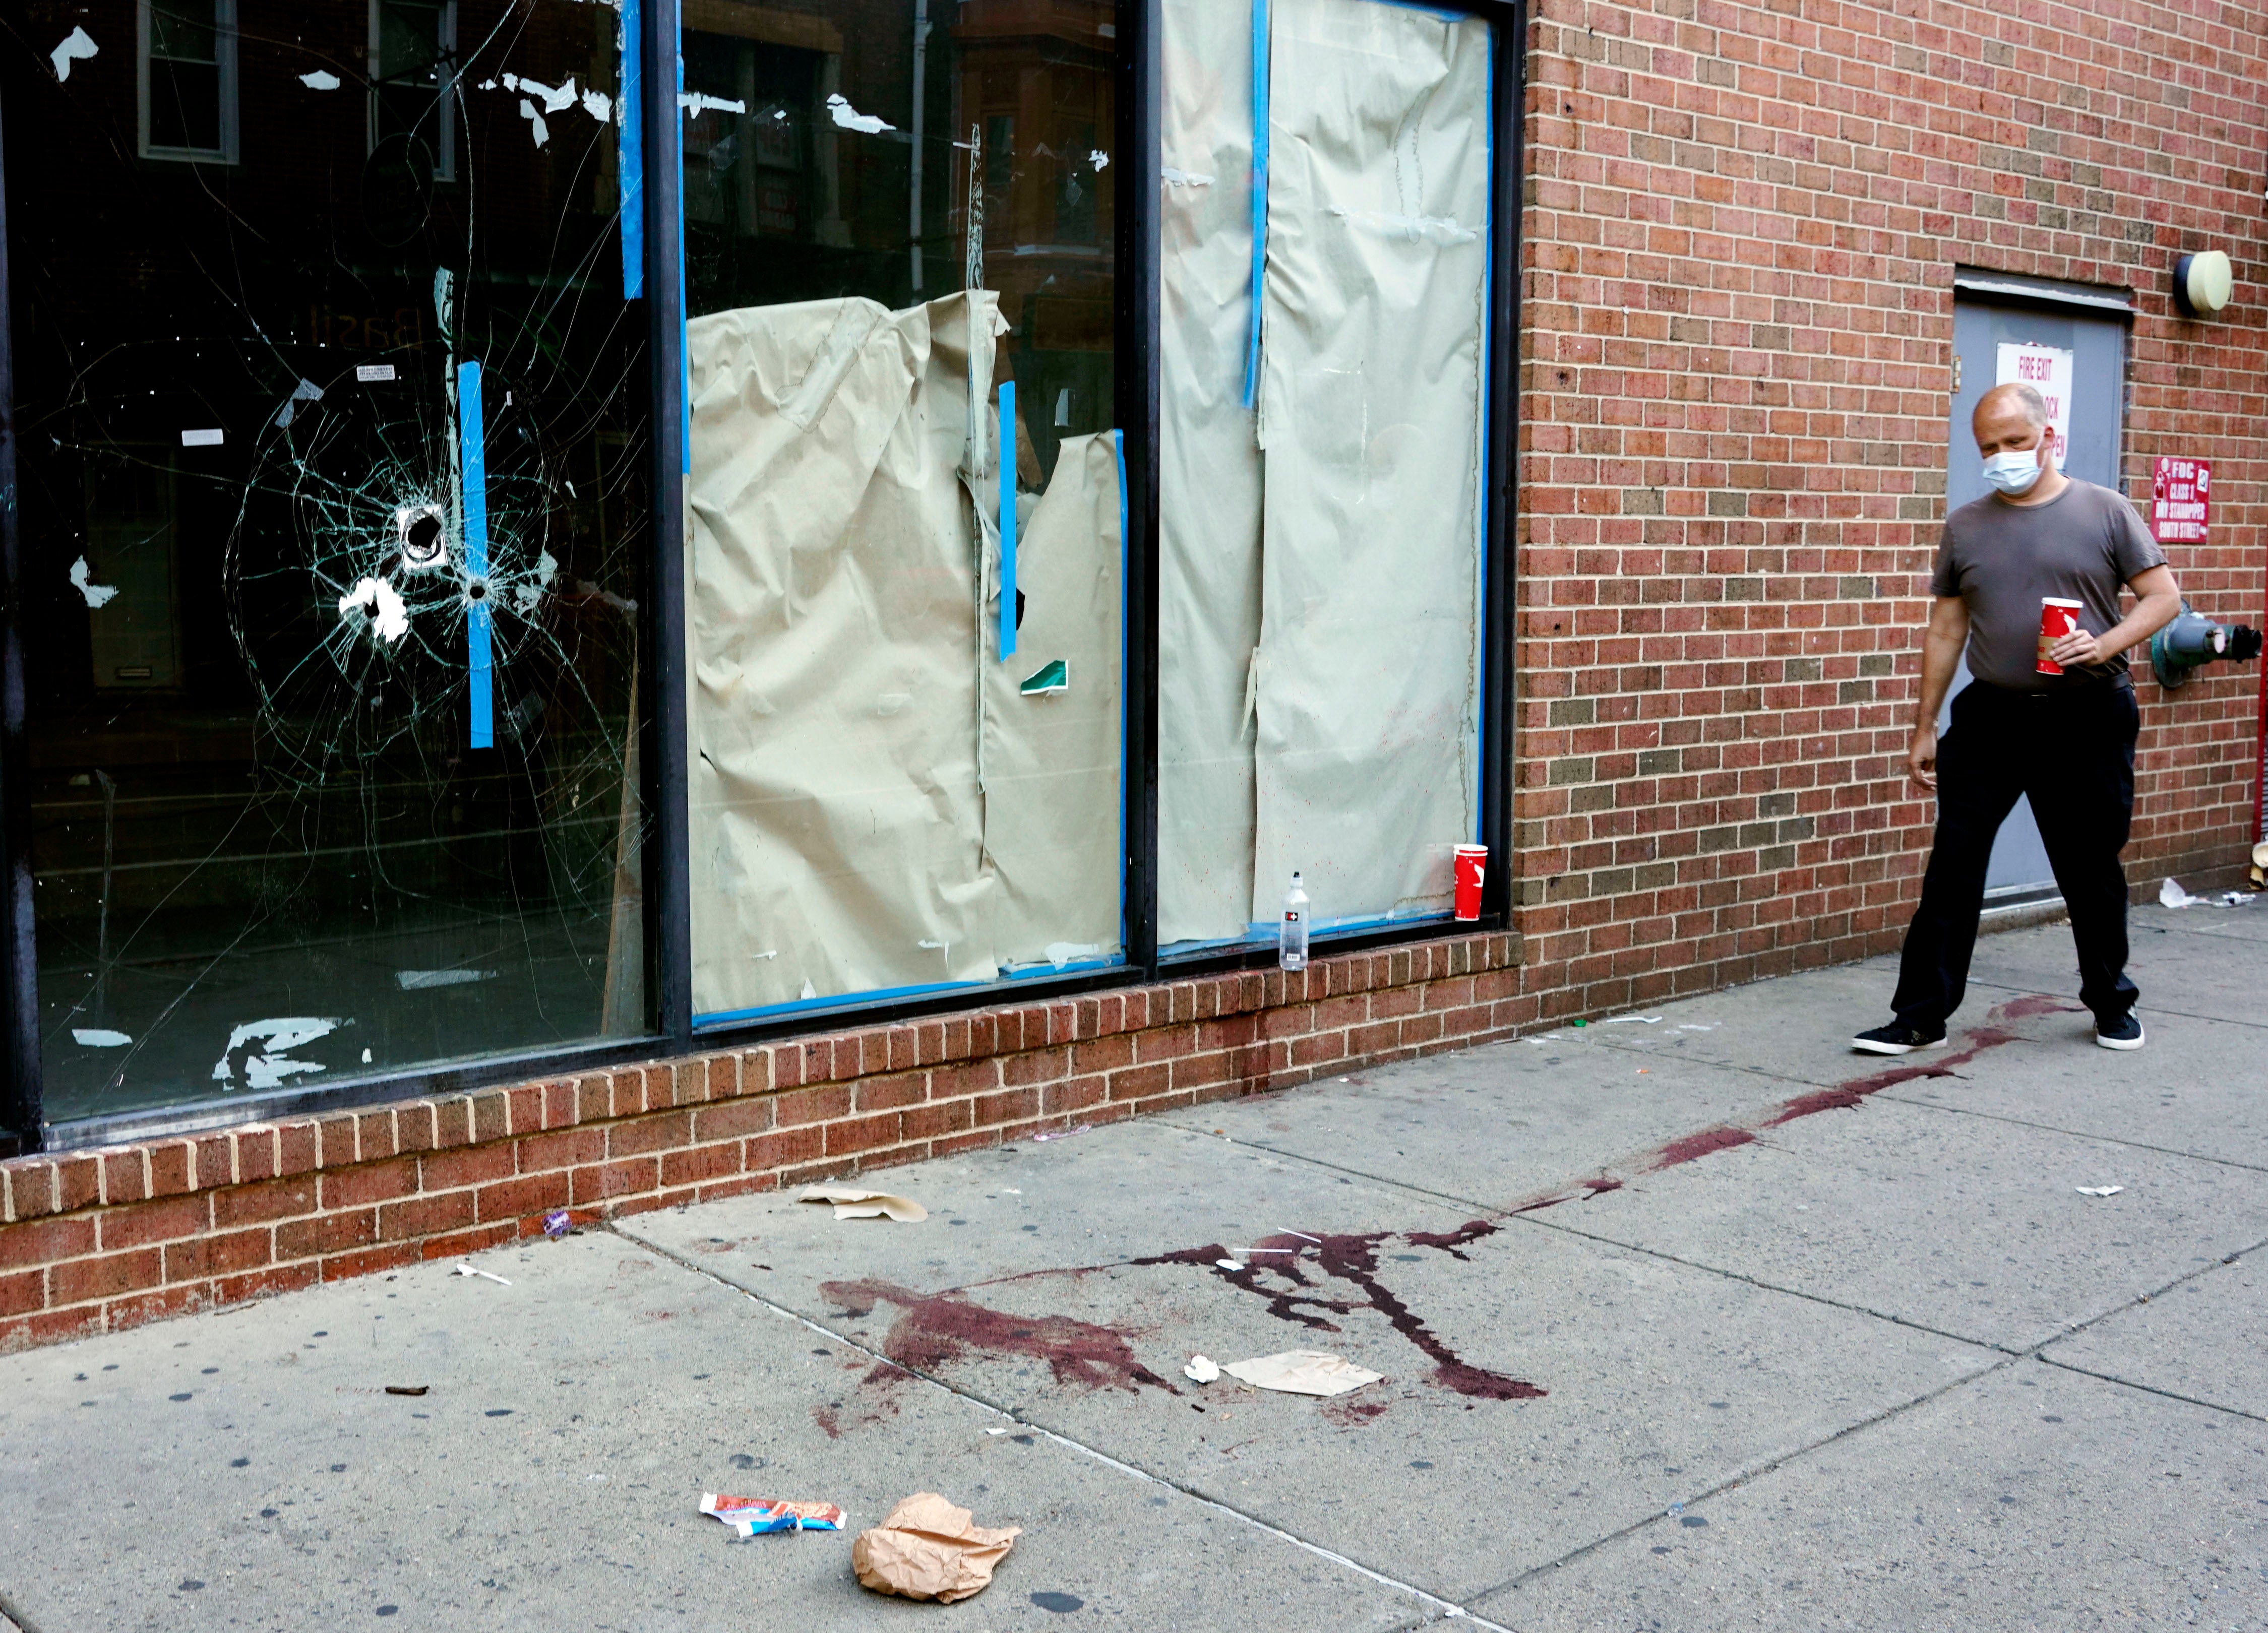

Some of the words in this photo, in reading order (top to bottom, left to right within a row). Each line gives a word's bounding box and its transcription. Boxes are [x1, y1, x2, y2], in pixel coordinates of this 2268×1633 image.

[2018, 356, 2034, 380] FIRE
[2037, 358, 2052, 381] EXIT
[2043, 396, 2059, 419] OCK
[2050, 434, 2065, 457] PEN
[2172, 462, 2194, 479] FDC
[2170, 483, 2189, 500] CLASS
[2159, 521, 2178, 538] SOUTH
[2179, 522, 2199, 538] STREET
